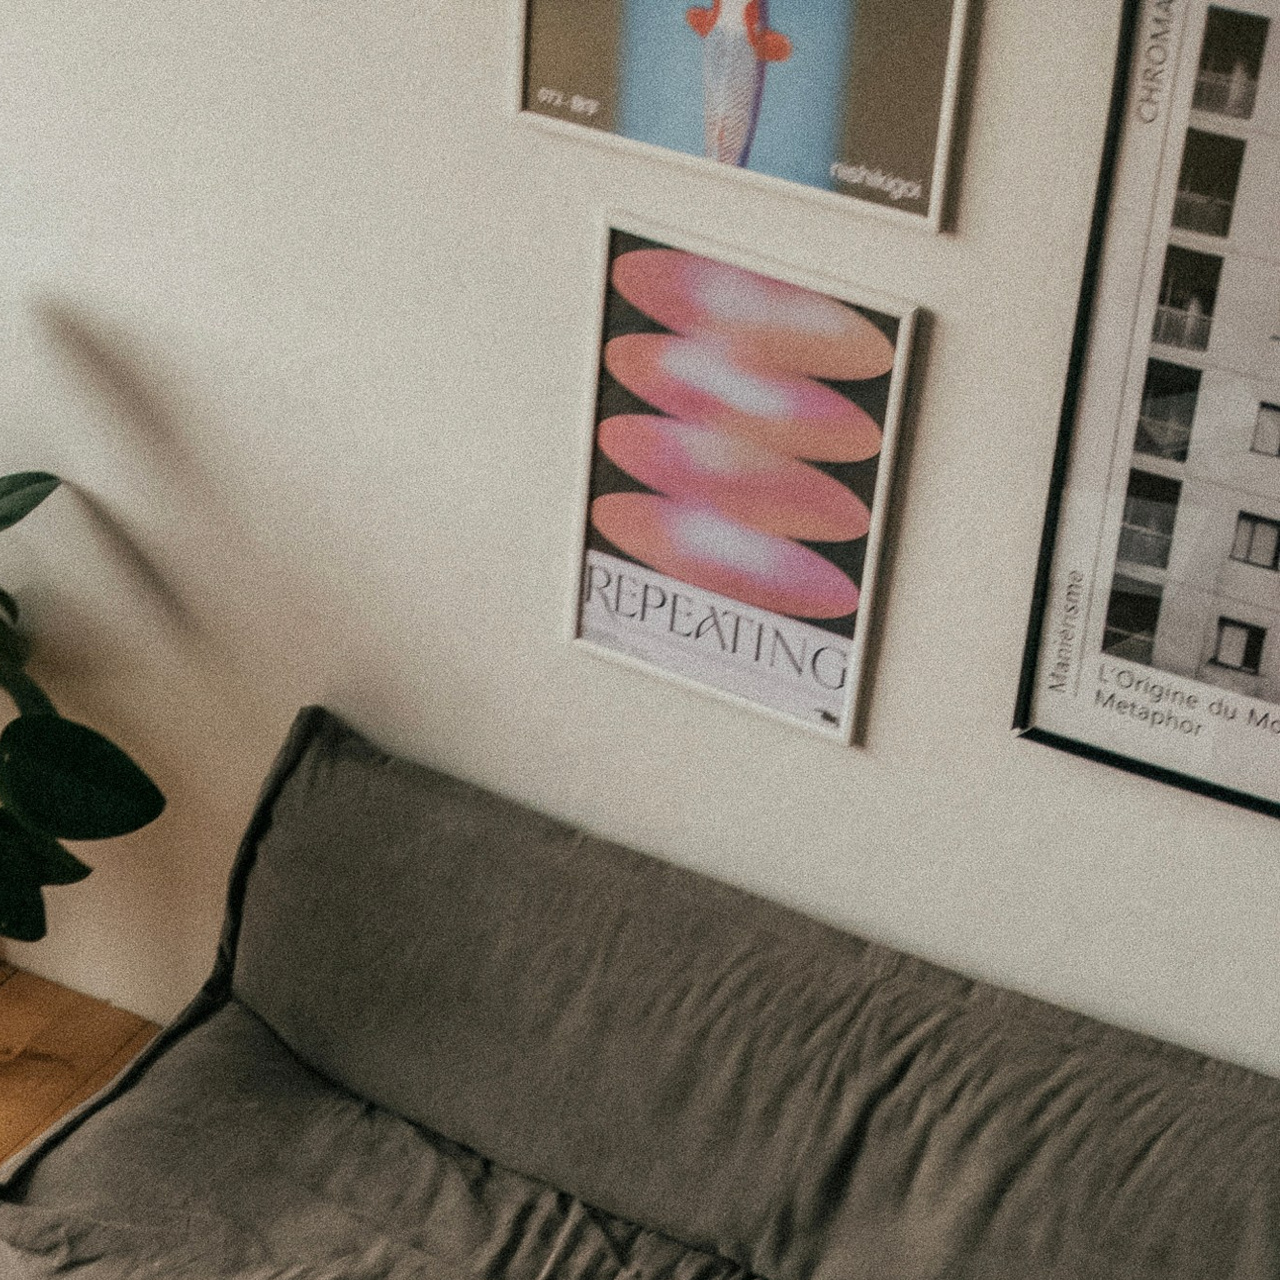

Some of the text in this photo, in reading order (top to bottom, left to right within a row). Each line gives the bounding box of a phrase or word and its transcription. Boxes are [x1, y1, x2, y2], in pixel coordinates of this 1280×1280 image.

[584, 564, 848, 691] REPEATING
[1094, 688, 1203, 737] Metaphor
[1208, 698, 1238, 721] du
